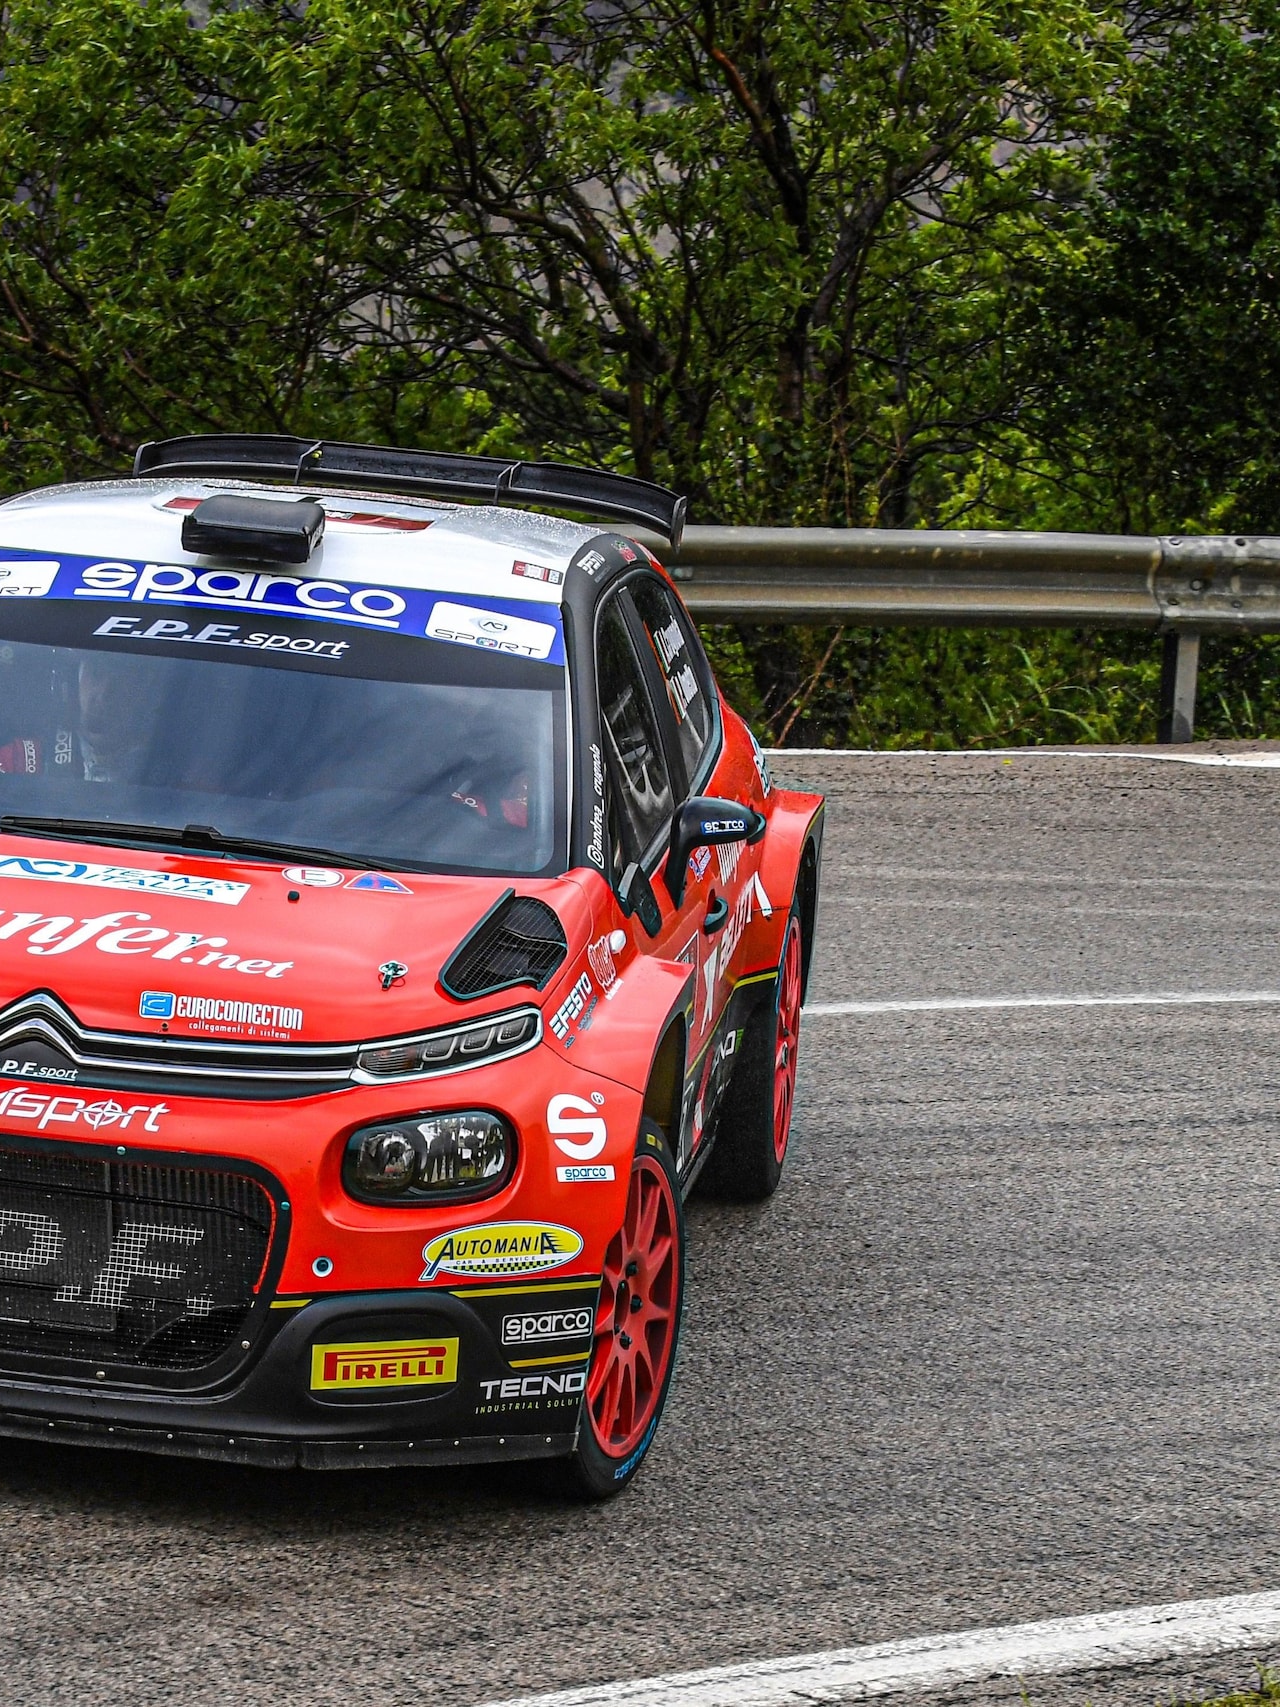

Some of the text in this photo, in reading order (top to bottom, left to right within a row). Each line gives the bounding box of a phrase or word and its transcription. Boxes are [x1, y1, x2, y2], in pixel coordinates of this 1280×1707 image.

[81, 562, 407, 620] sparco
[85, 872, 216, 898] ITALIA
[102, 866, 208, 889] TEAM
[176, 995, 304, 1031] EUROCONNECTION
[549, 971, 593, 1041] EFESTO
[188, 1020, 291, 1040] collegamenti di sistemi
[565, 1167, 607, 1182] sparco
[505, 1311, 590, 1341] sparco
[323, 1346, 448, 1382] PIRELLI
[480, 1372, 586, 1401] TECNO
[475, 1397, 580, 1415] INDUSTRIAL SOLUT
